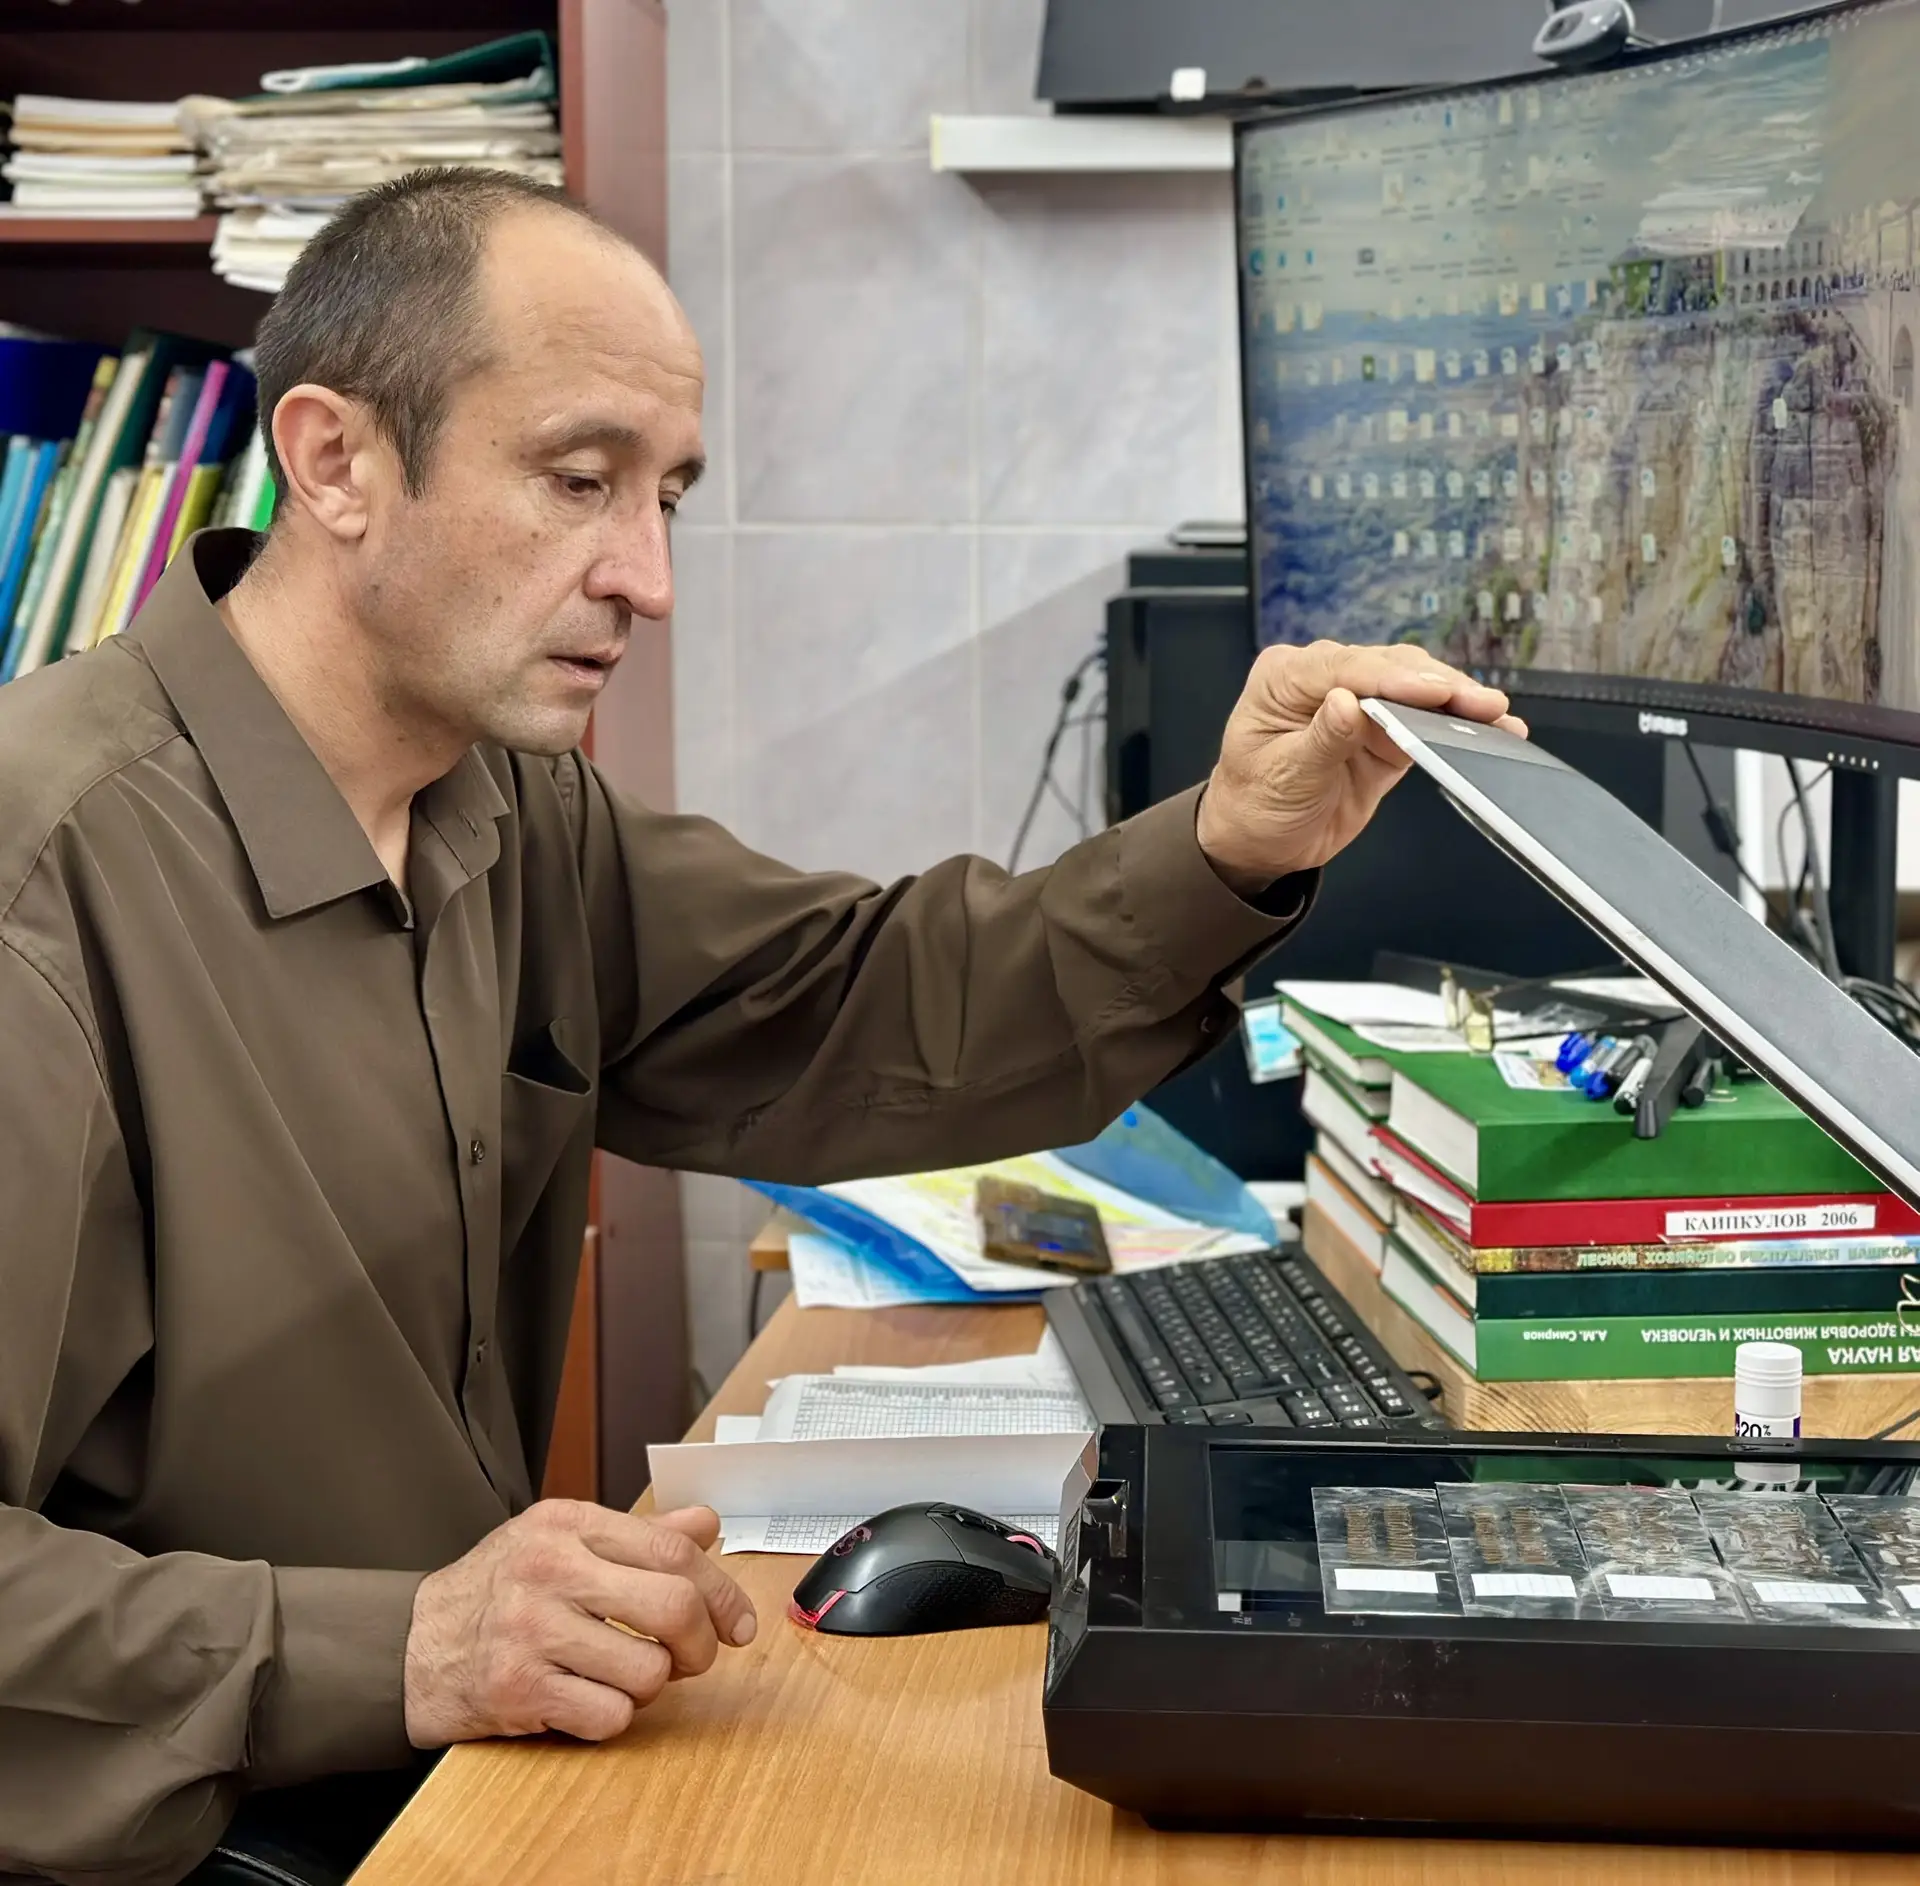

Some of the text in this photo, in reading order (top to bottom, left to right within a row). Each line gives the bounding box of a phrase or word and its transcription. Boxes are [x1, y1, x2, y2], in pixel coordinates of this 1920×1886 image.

[1821, 1211, 1858, 1227] 2006
[1576, 1252, 1637, 1267] ЛЕСНОЕ
[1645, 1248, 1735, 1265] ХОЗЯЙСТВО
[1522, 1328, 1608, 1342] А.М. Смирнов
[1640, 1328, 1716, 1343] ЧЕЛОВЕКА
[1718, 1328, 1731, 1341] И
[1733, 1325, 1818, 1341] ЖИВОТНЫХ
[1820, 1322, 1897, 1339] ЗДОРОВЬЯ
[1827, 1346, 1893, 1365] НАУКА
